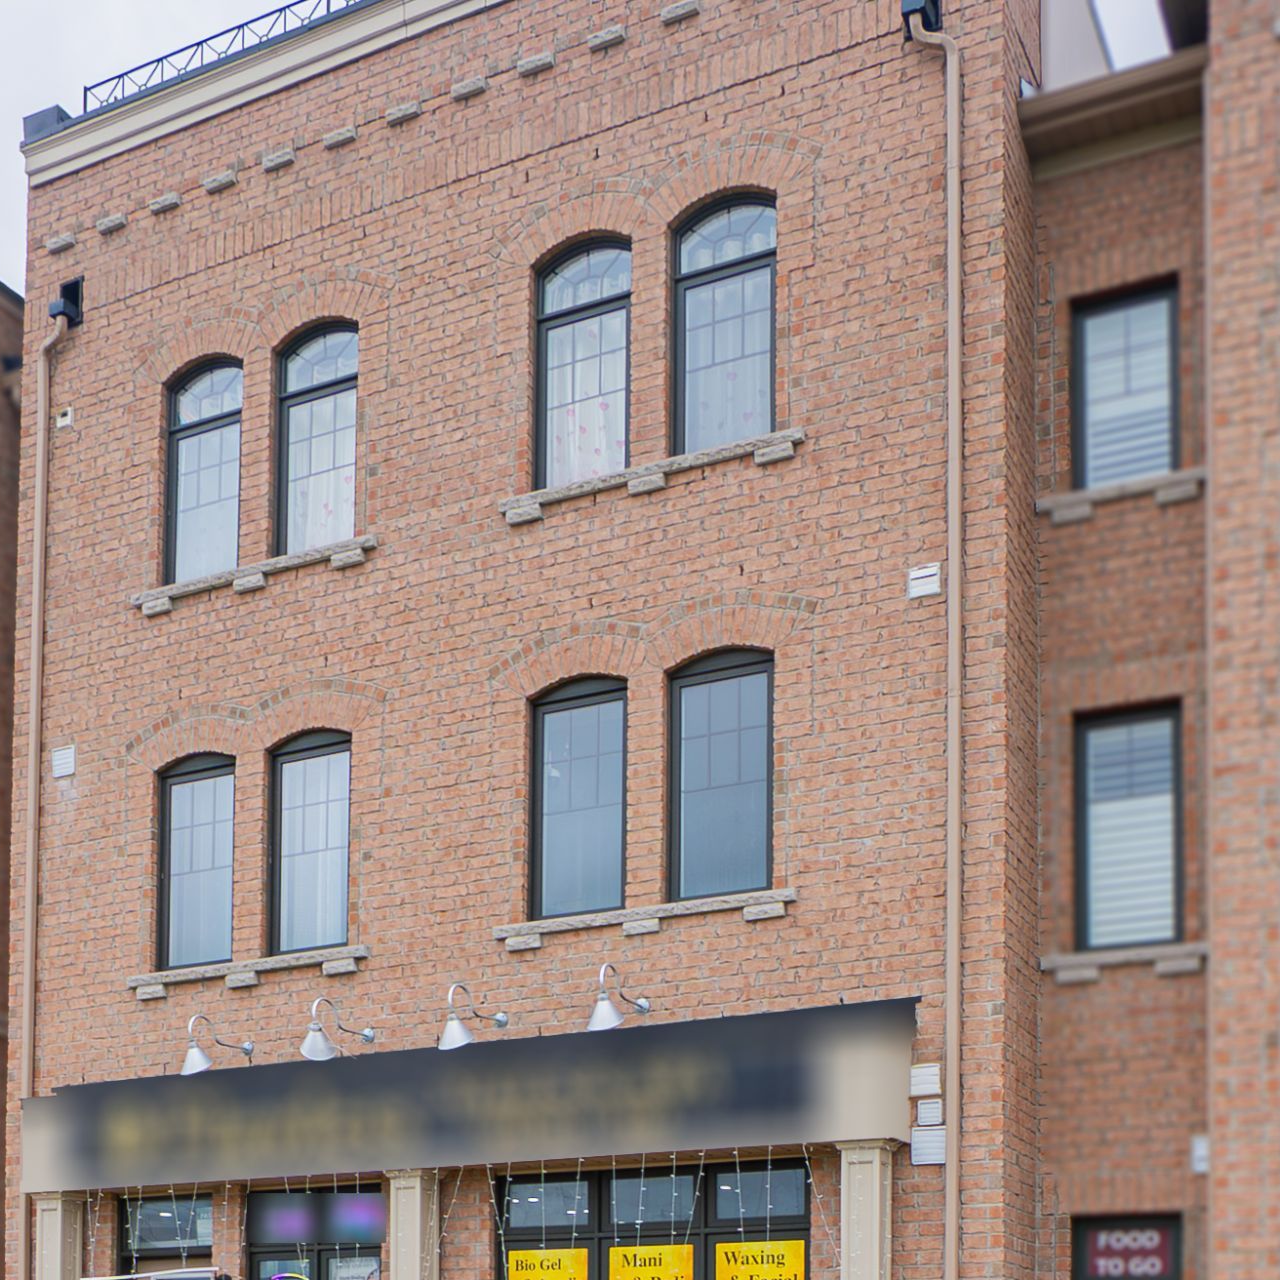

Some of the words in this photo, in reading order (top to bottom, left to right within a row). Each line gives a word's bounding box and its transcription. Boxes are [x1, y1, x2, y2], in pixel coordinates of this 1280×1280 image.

[1097, 1230, 1160, 1250] FOOD
[515, 1259, 536, 1272] Bio
[539, 1258, 562, 1271] Gel
[622, 1252, 663, 1268] Mani
[724, 1250, 785, 1269] Waxing
[1096, 1258, 1123, 1276] TO
[1128, 1257, 1162, 1276] GO
